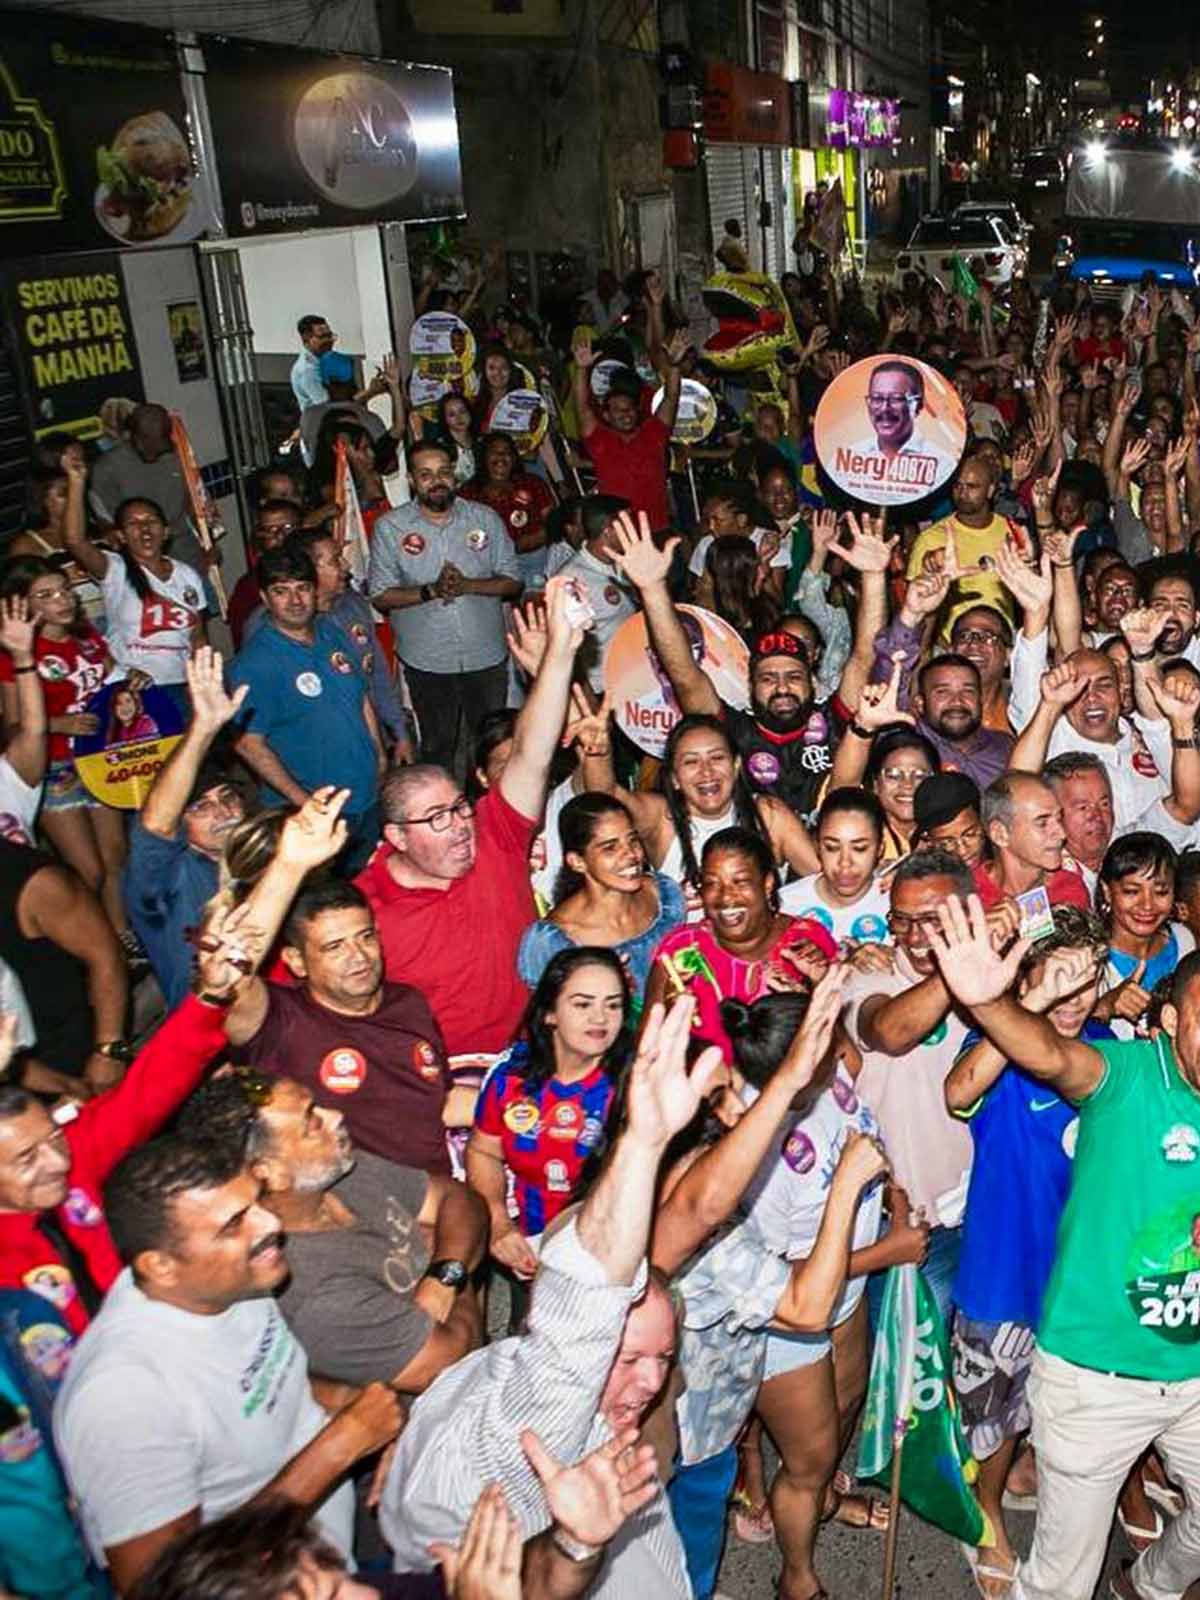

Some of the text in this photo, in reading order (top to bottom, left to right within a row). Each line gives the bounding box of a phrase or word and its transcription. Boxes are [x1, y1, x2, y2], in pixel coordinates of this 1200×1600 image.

[18, 274, 120, 309] SERVIMOS
[26, 303, 126, 347] CAFÉ DA
[33, 334, 133, 389] MANHÃ
[836, 448, 886, 480] Nery
[146, 604, 189, 630] 13
[626, 701, 673, 736] Nery
